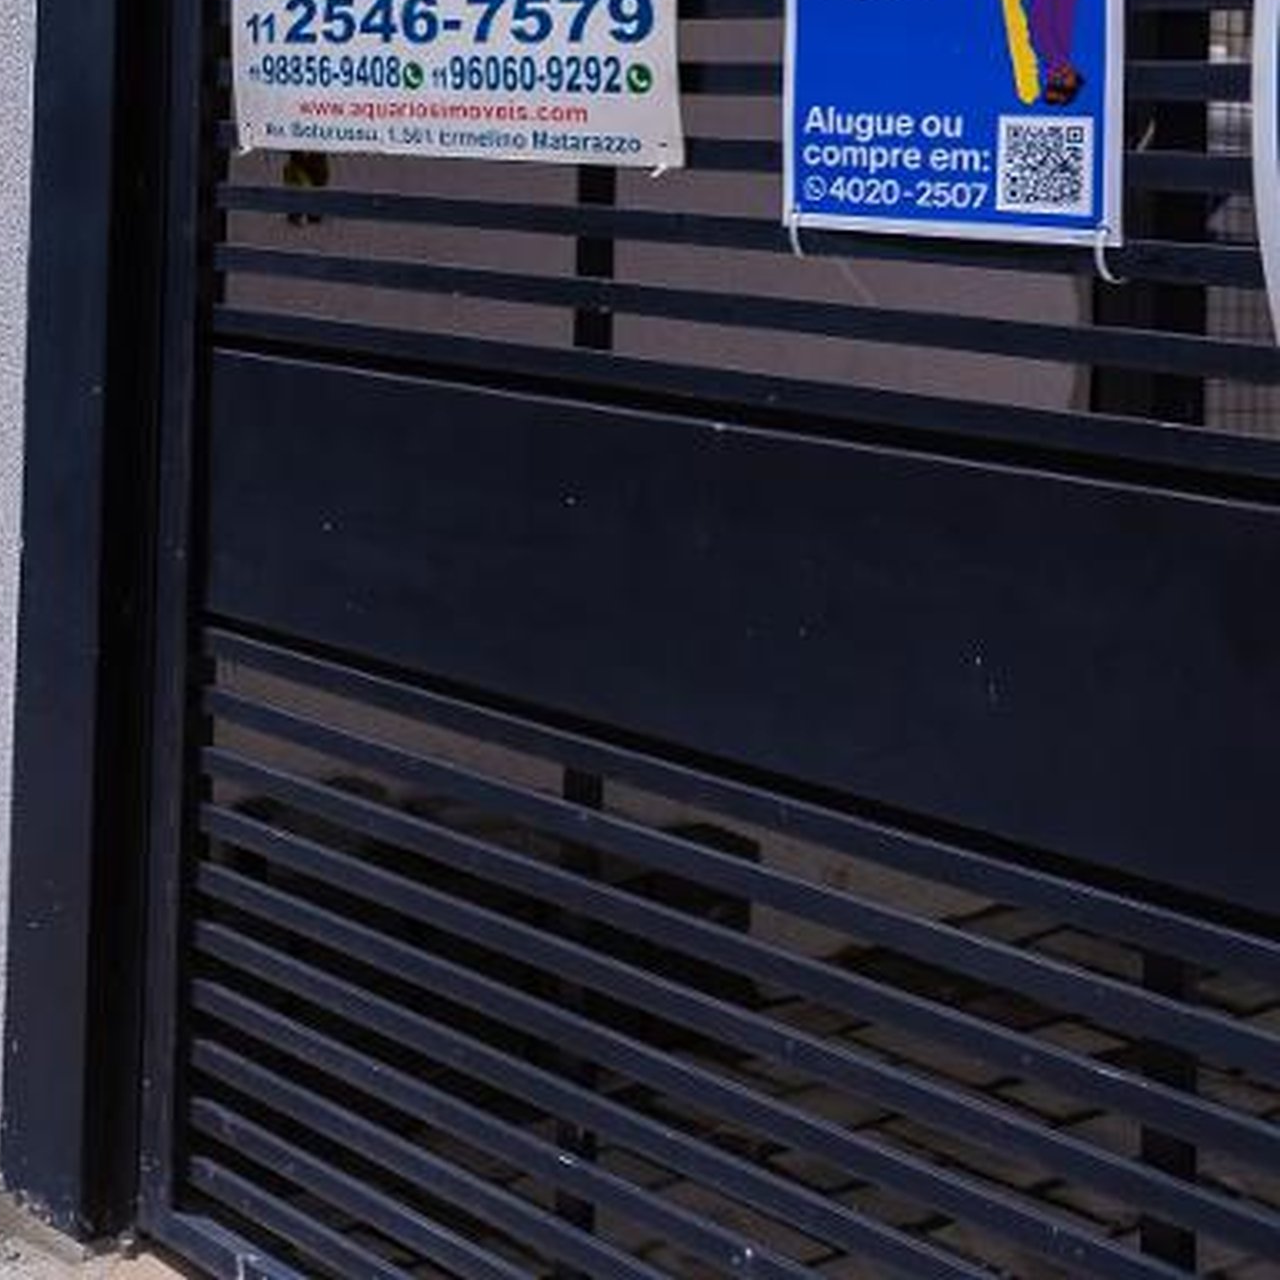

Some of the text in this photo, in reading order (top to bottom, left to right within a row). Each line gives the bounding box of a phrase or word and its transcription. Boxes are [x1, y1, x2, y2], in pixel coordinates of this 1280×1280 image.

[246, 12, 276, 45] 11
[449, 55, 623, 94] 96060-9292
[299, 101, 588, 123] www.aquariosimoveis.com
[803, 105, 964, 143] Alugue ou
[803, 143, 992, 175] compre em:
[828, 175, 989, 209] 4020-2507
